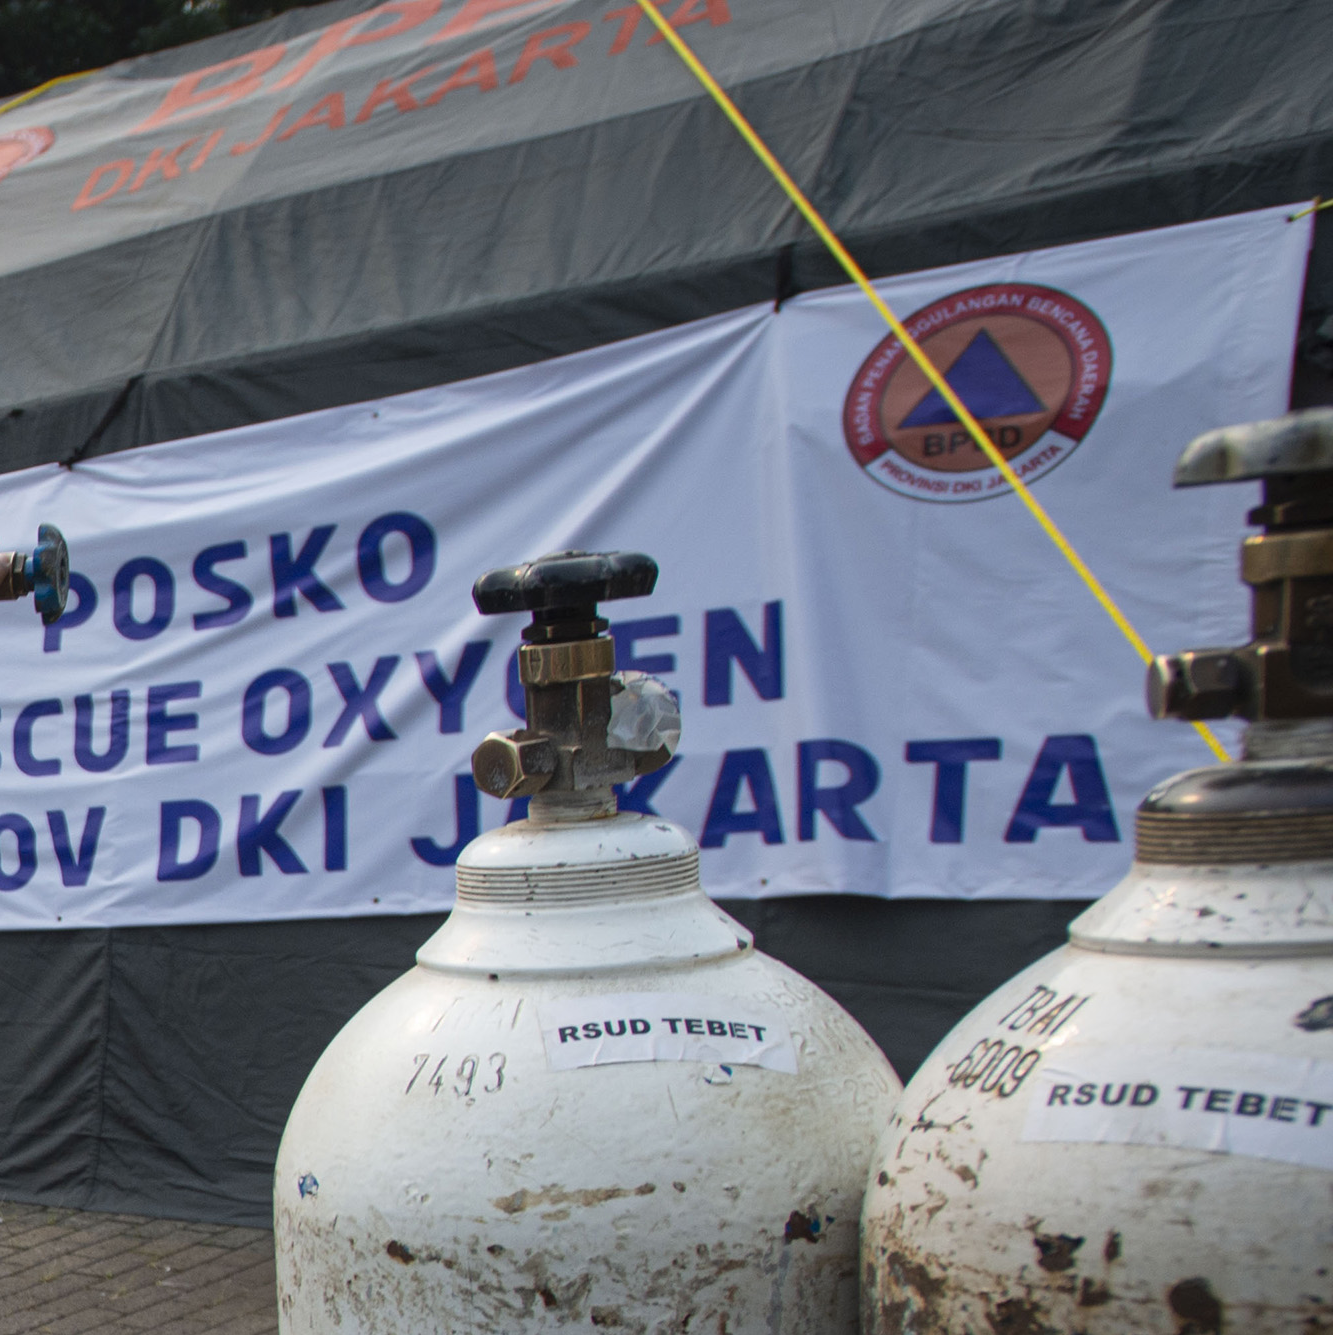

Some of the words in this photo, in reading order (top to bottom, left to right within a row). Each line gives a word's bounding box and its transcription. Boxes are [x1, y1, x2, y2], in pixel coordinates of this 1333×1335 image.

[70, 129, 226, 213] DKI
[230, 0, 735, 158] JAKARTA
[853, 390, 875, 446] BADAN
[1026, 295, 1095, 350] BENCANA
[1069, 351, 1099, 421] DAERAH
[880, 459, 950, 494] PROVINSI
[952, 481, 982, 494] DKI
[986, 443, 1064, 490] JAARTA
[241, 601, 784, 757] OXYEN
[156, 785, 348, 883] DKI
[557, 1016, 652, 1045] RSUD
[661, 1016, 767, 1043] TEBET
[1046, 1083, 1161, 1109] RSUD
[1178, 1085, 1333, 1128] TEBET
